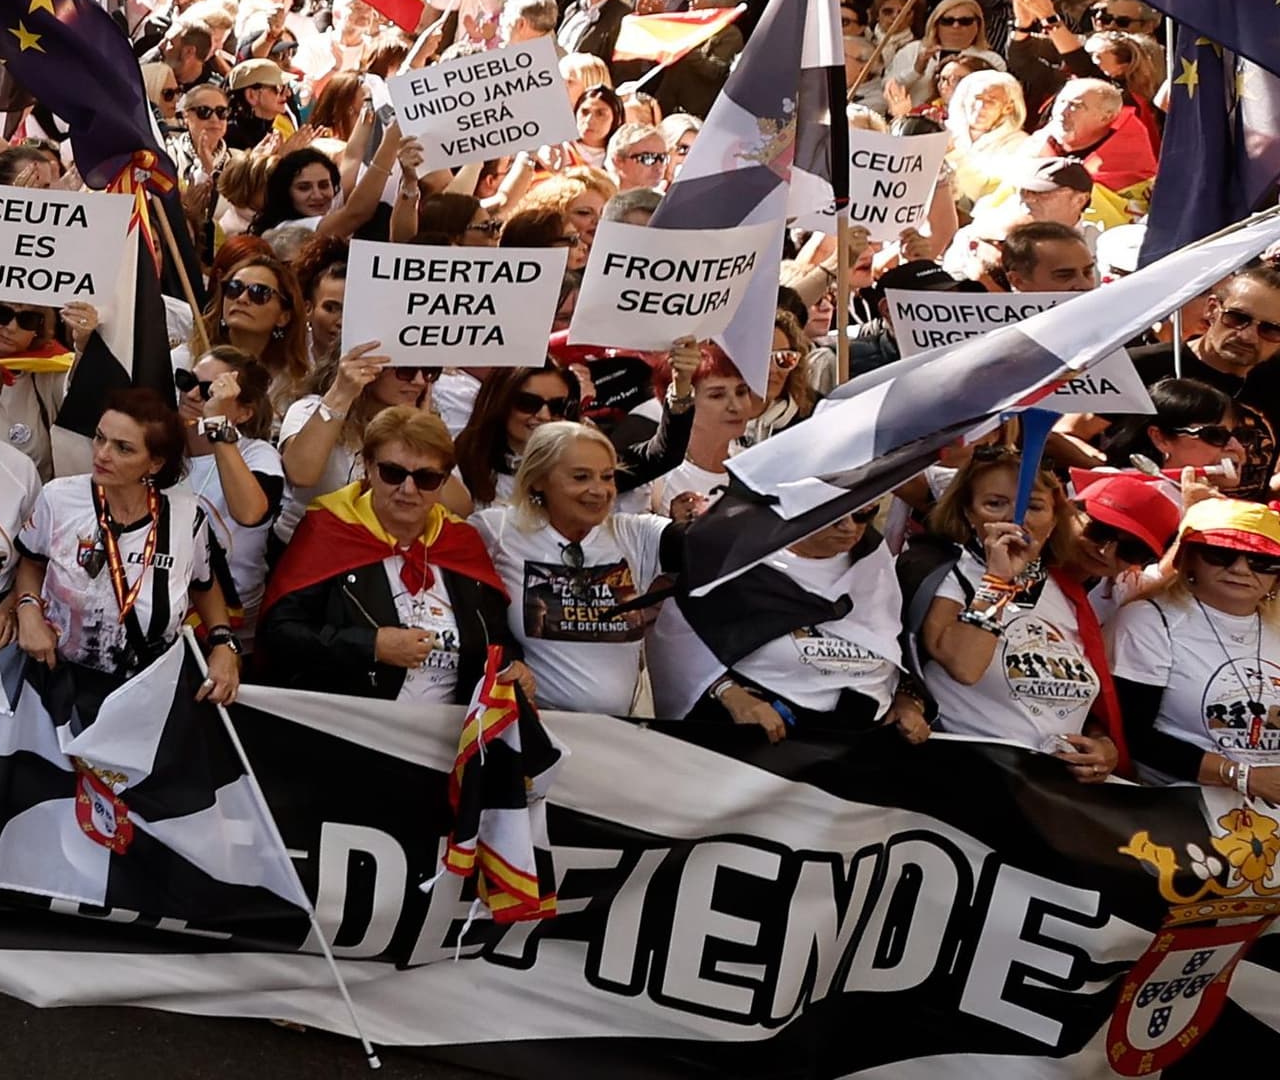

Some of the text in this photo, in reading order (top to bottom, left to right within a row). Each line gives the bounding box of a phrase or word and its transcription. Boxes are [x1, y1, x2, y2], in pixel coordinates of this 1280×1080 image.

[411, 52, 533, 97] EL PUEBLO
[404, 69, 554, 121] UNIDO JAMÁS
[456, 101, 515, 132] SERÁ
[440, 121, 540, 157] VENCIDO
[851, 150, 923, 174] CEUTA
[872, 180, 908, 199] NO
[850, 202, 888, 224] UN
[14, 233, 56, 259] ES
[371, 255, 543, 284] LIBERTAD
[602, 251, 757, 283] FRONTERA
[406, 292, 497, 316] PARA
[616, 287, 731, 317] SEGURA
[398, 324, 505, 347] CEUTA
[1005, 684, 1092, 699] CABALLAS
